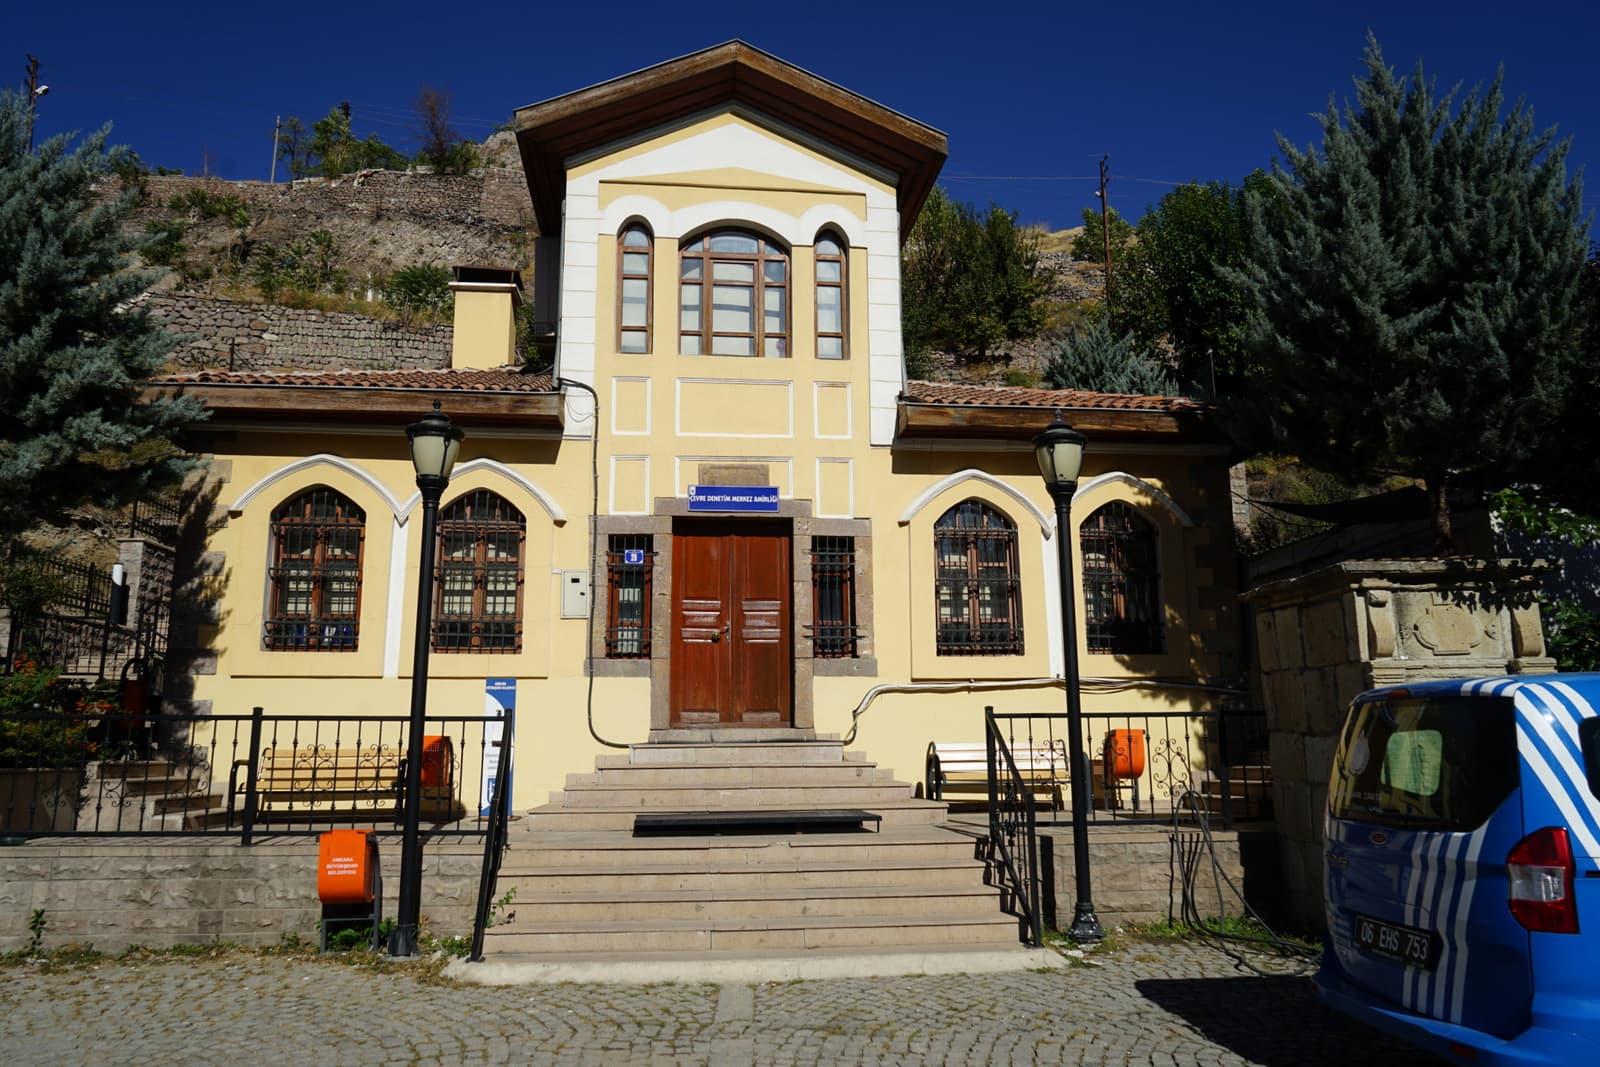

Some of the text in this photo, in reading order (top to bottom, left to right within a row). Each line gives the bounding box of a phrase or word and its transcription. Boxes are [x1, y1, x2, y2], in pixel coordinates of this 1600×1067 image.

[1361, 920, 1375, 944] 06
[1379, 926, 1400, 952] EHS
[1405, 934, 1429, 961] 753
